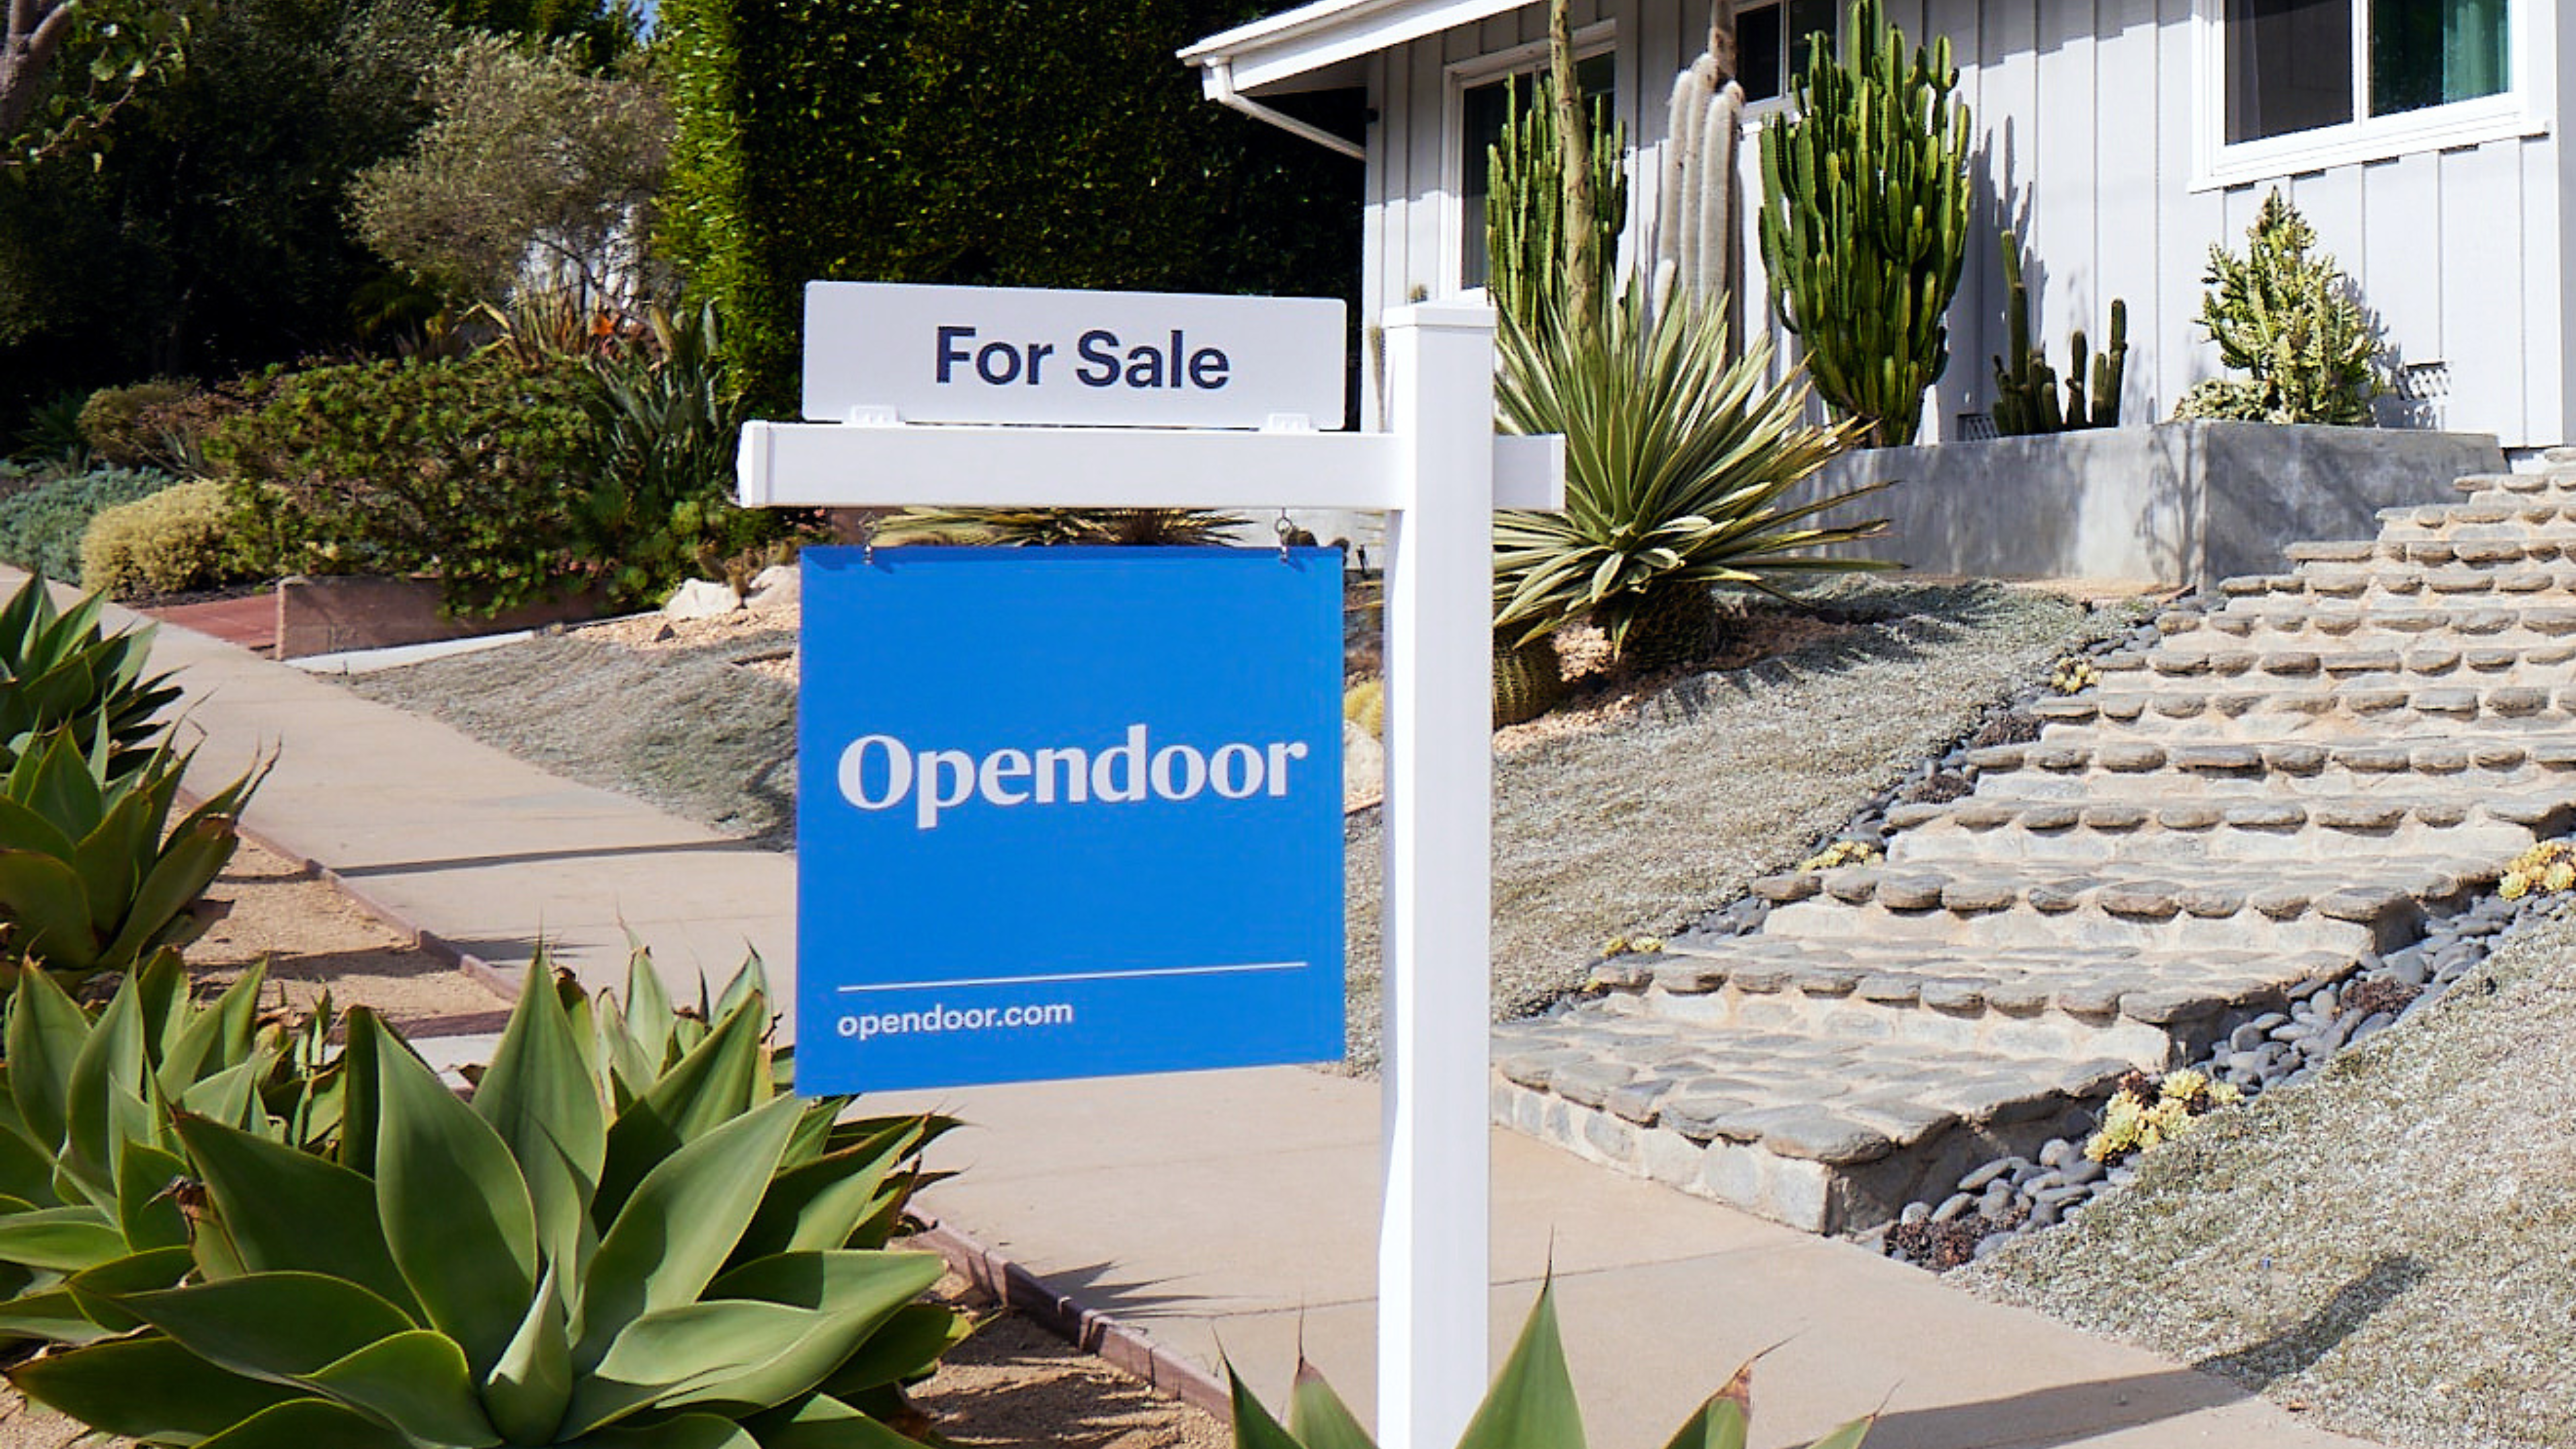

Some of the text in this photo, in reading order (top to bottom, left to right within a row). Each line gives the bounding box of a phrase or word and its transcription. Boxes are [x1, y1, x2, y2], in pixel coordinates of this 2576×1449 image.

[936, 326, 1229, 389] For Sale
[838, 724, 1308, 829] Opendoor
[837, 1004, 1074, 1041] opendoor.com
